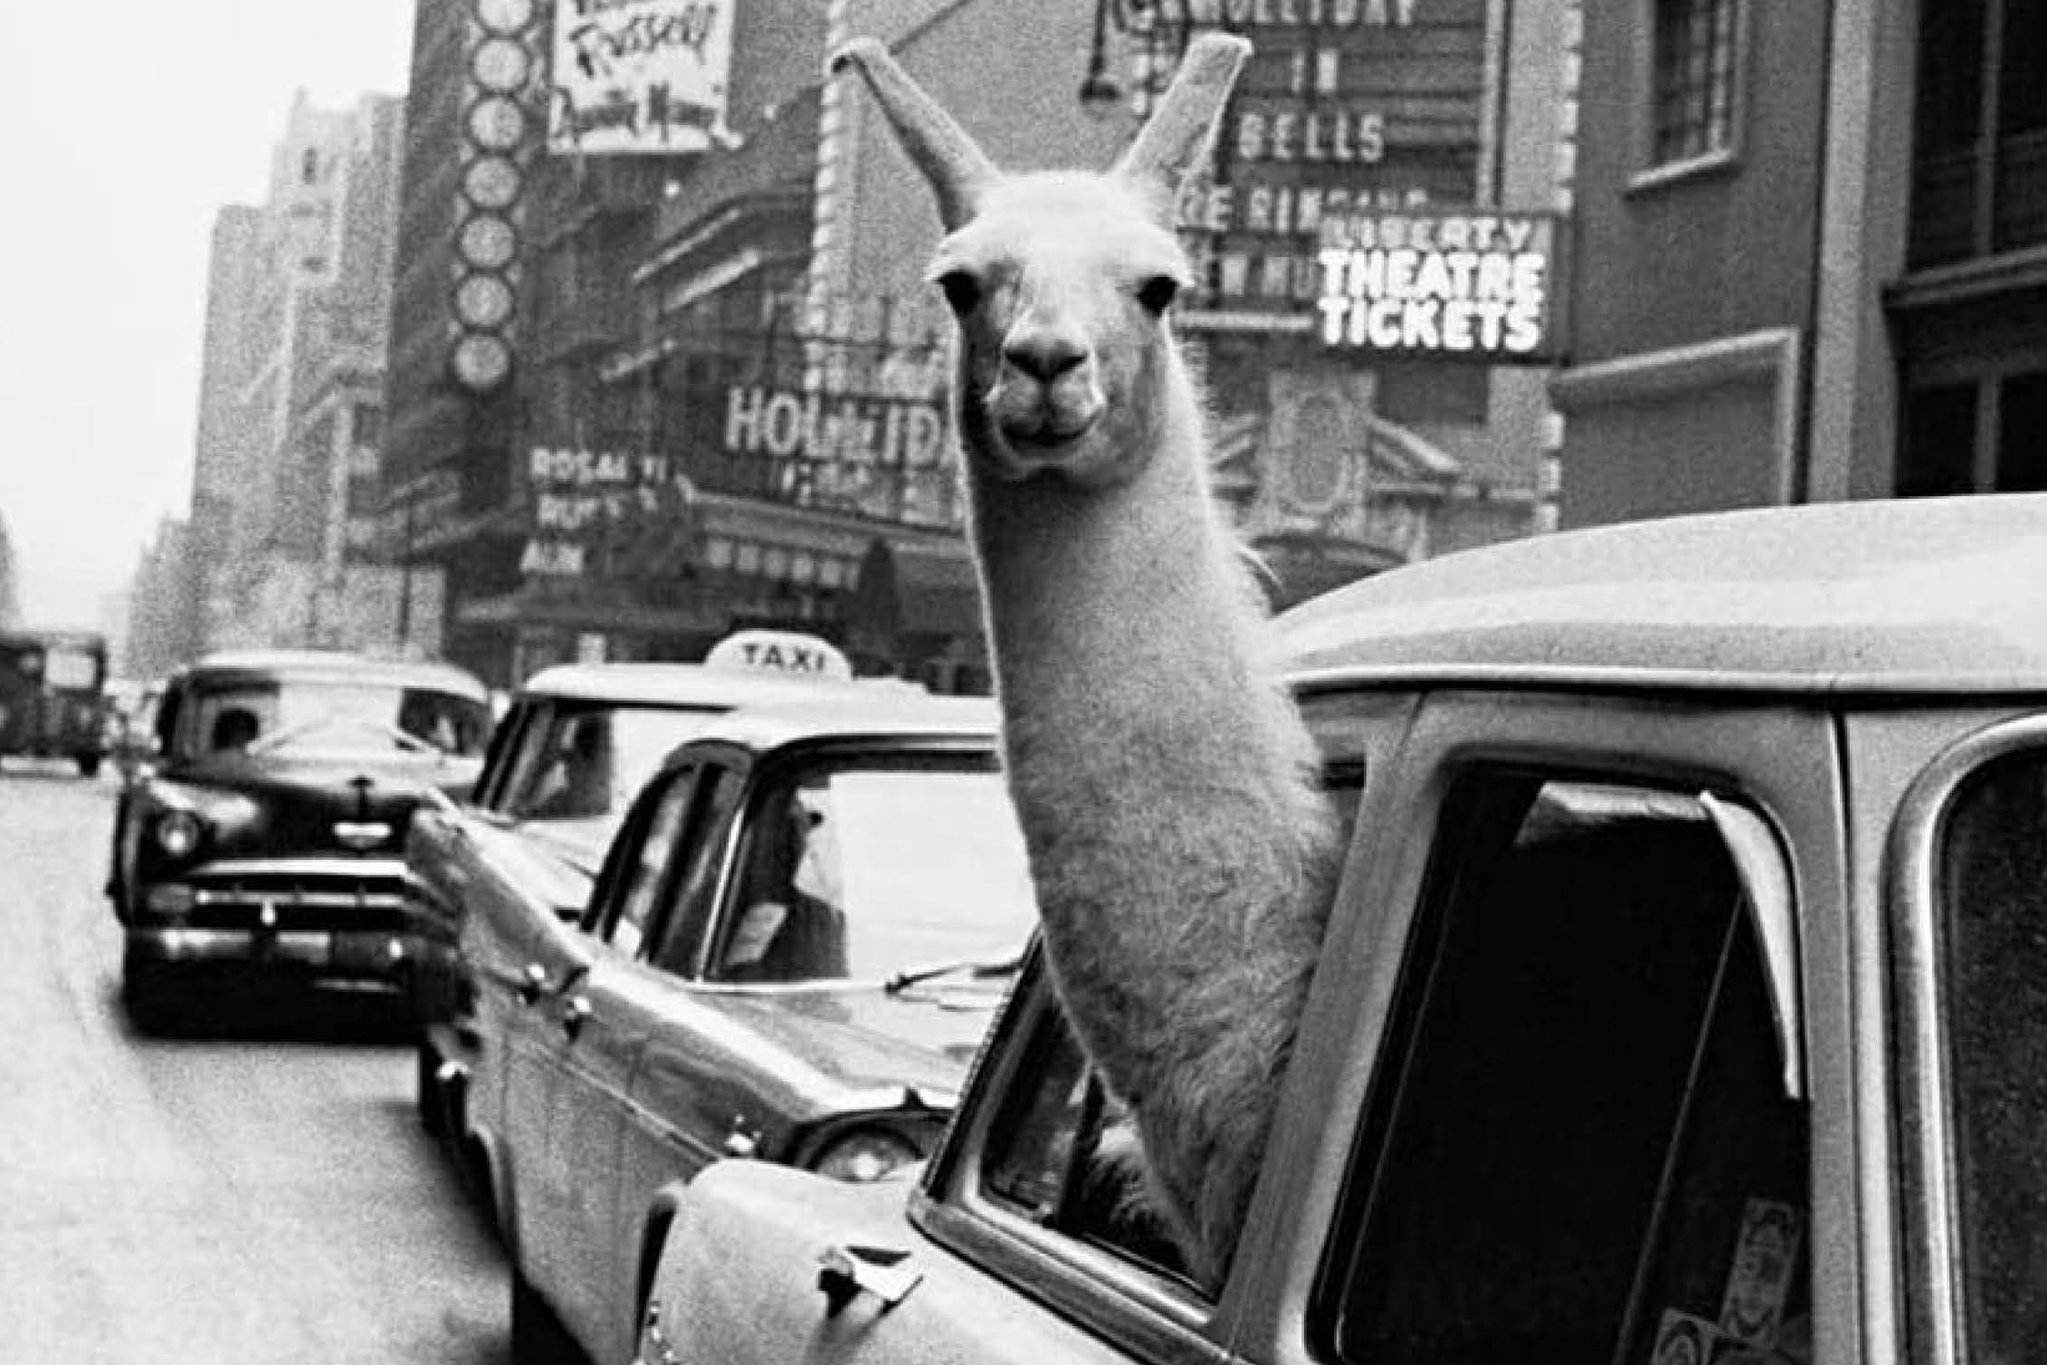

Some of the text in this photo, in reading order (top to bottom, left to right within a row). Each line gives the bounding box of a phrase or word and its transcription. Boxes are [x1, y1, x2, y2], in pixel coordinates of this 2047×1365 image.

[1238, 113, 1386, 162] BELLS
[1318, 248, 1545, 303] THEATRE
[1318, 297, 1541, 352] TICKETS
[741, 642, 825, 672] TAXI
